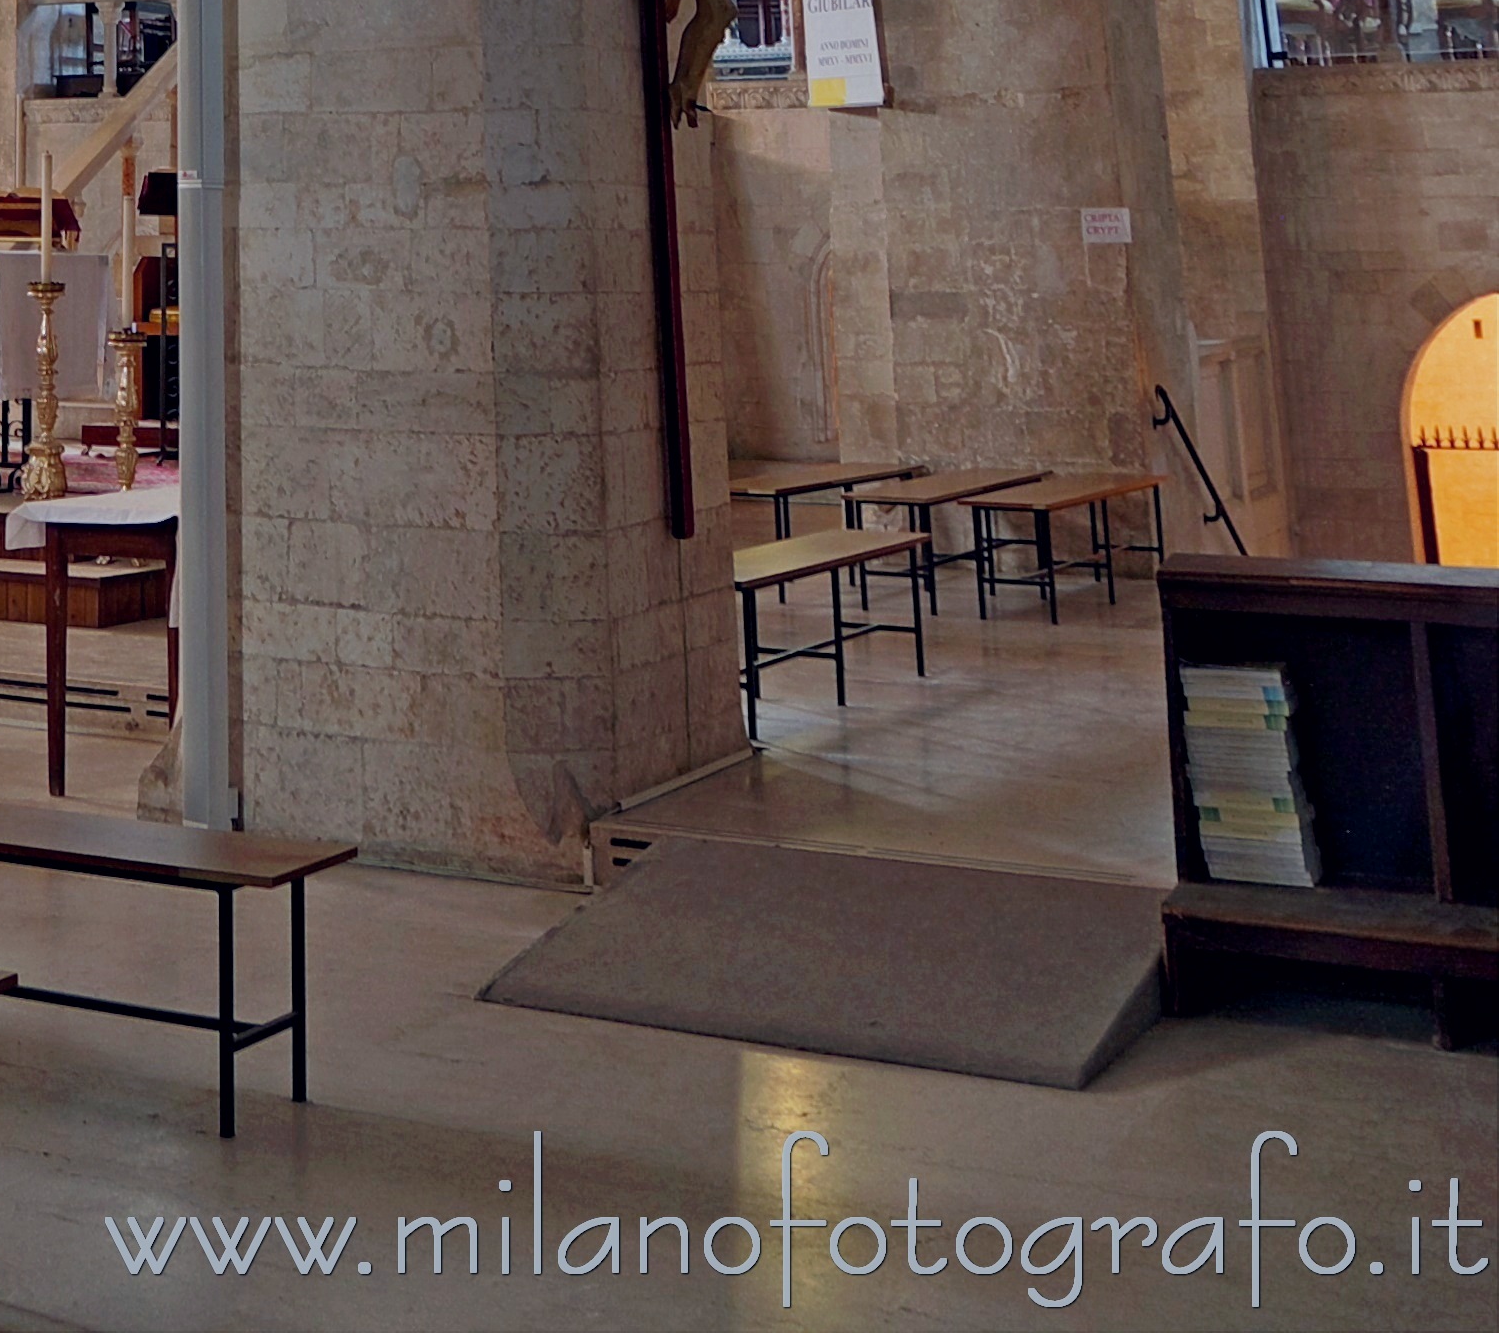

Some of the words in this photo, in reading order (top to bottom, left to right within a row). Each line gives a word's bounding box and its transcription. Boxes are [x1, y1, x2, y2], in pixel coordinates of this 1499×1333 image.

[820, 40, 839, 51] ANNO
[839, 38, 869, 50] DOMINI
[844, 53, 873, 65] MMXVI
[1084, 213, 1121, 223] CRIPTA
[1086, 226, 1119, 235] CRYPT
